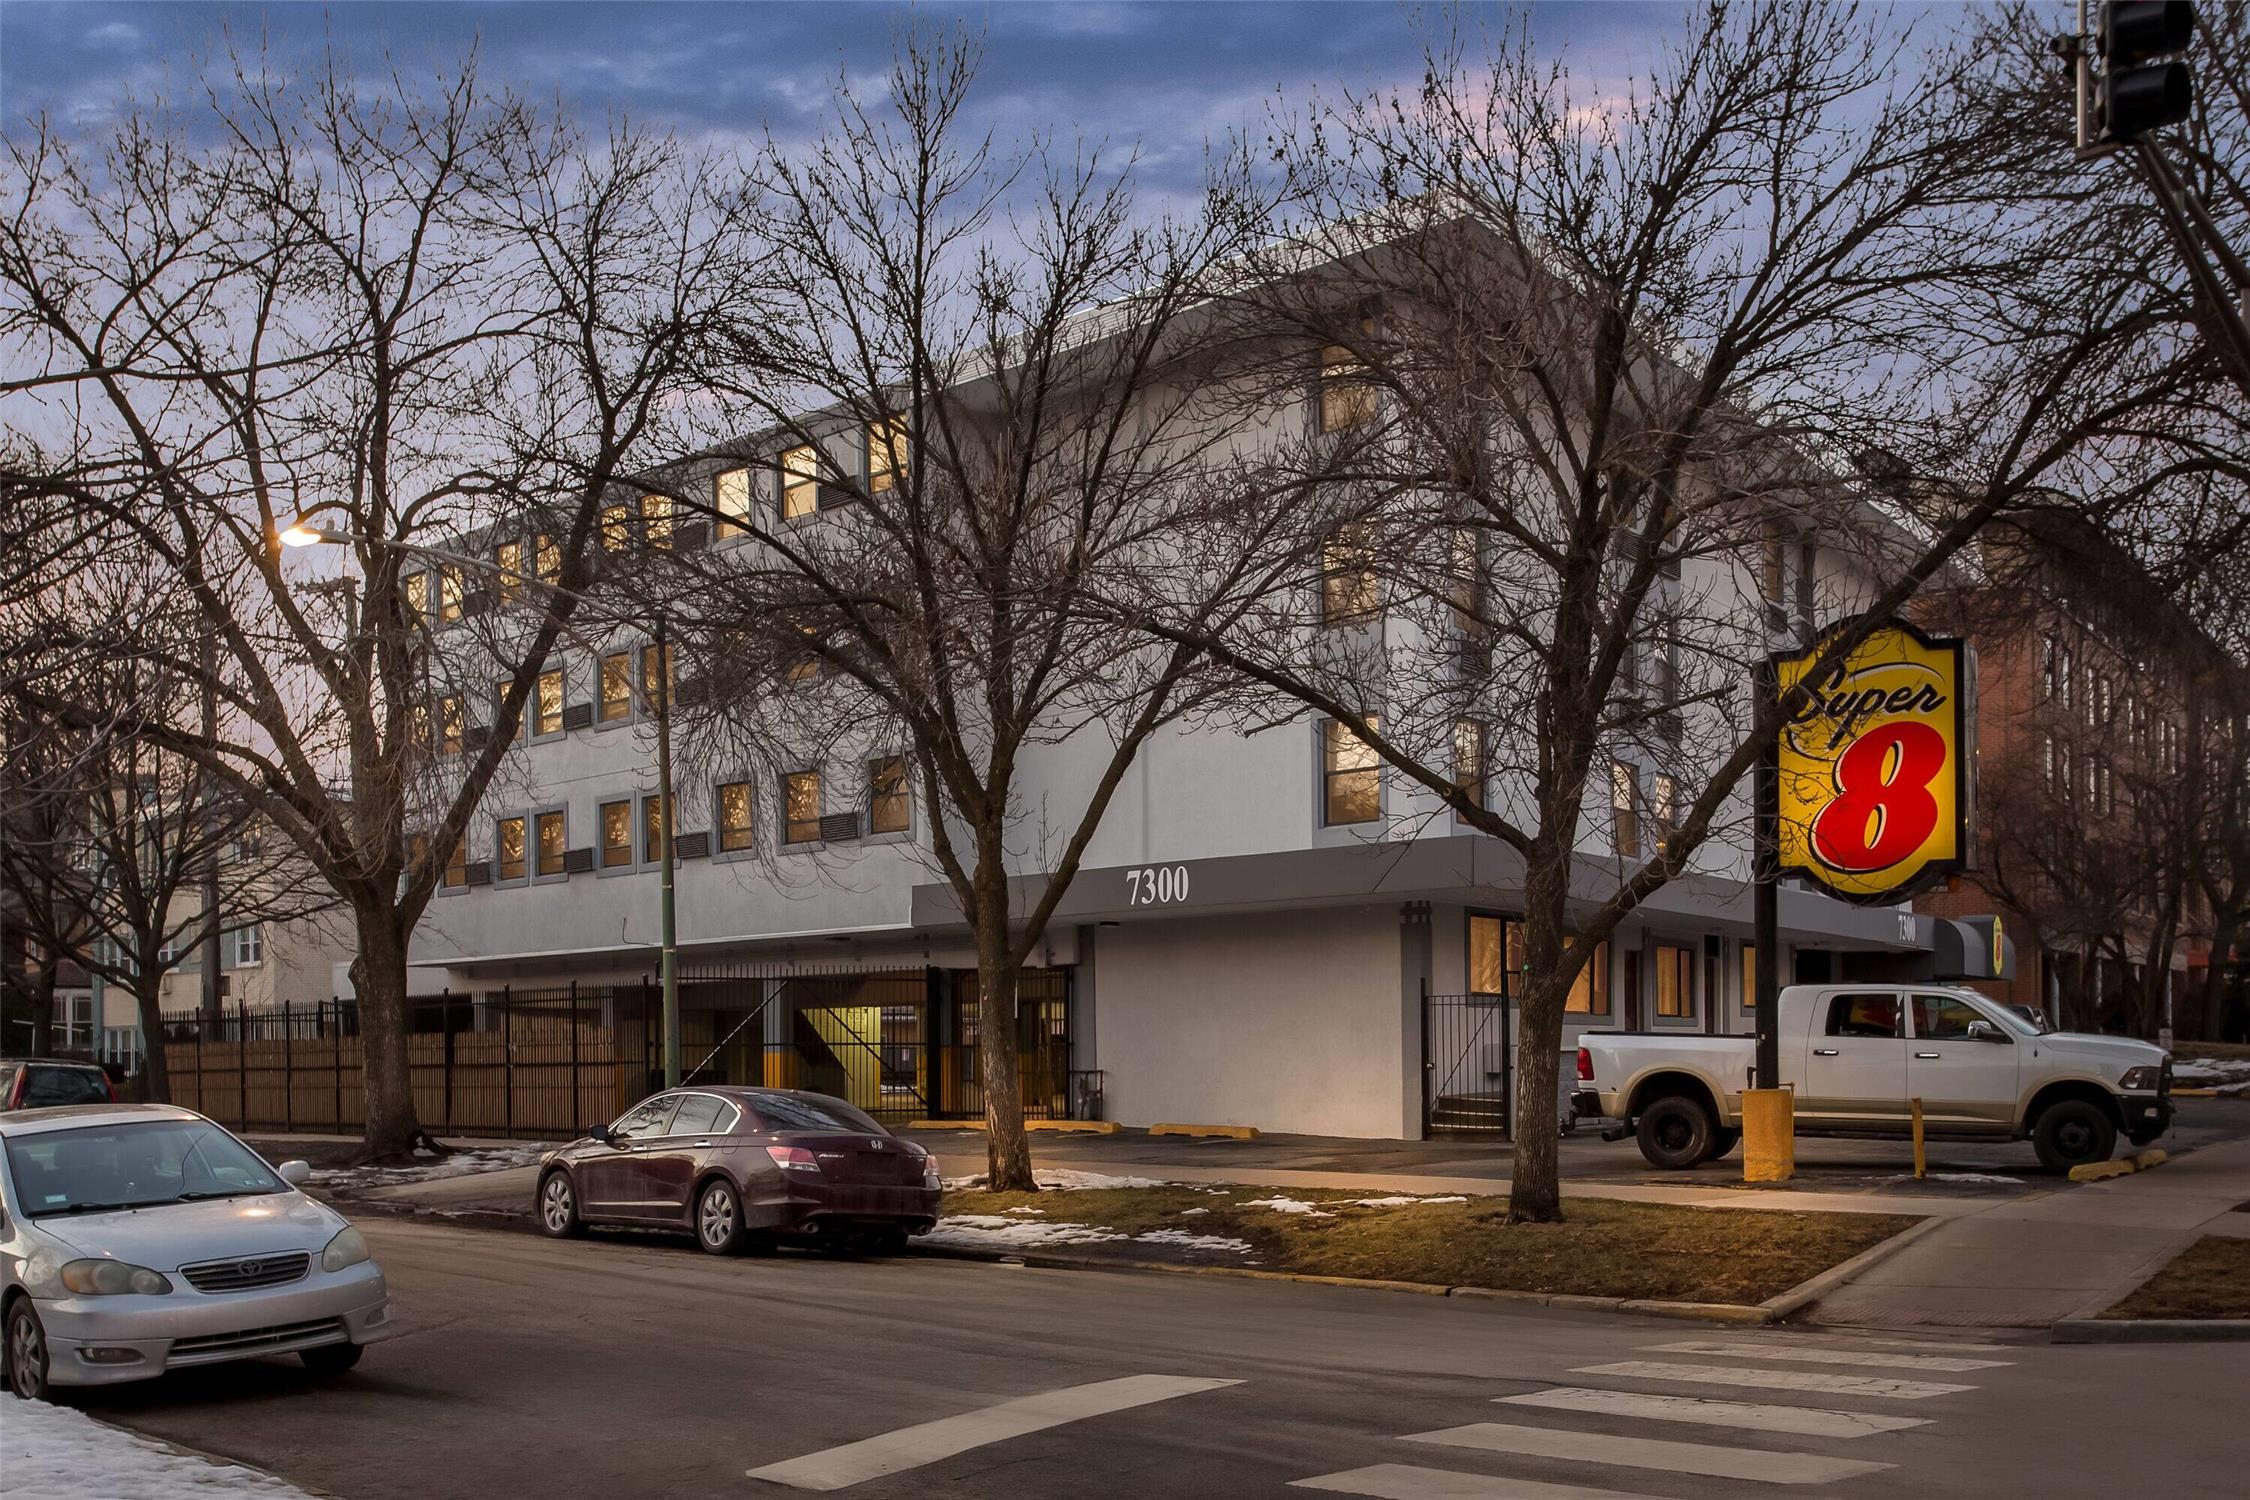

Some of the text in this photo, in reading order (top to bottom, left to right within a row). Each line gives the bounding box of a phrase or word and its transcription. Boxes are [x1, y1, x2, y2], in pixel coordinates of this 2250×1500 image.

[1808, 721, 1947, 874] 8
[1126, 865, 1189, 905] 7300
[1898, 914, 1916, 942] 7300
